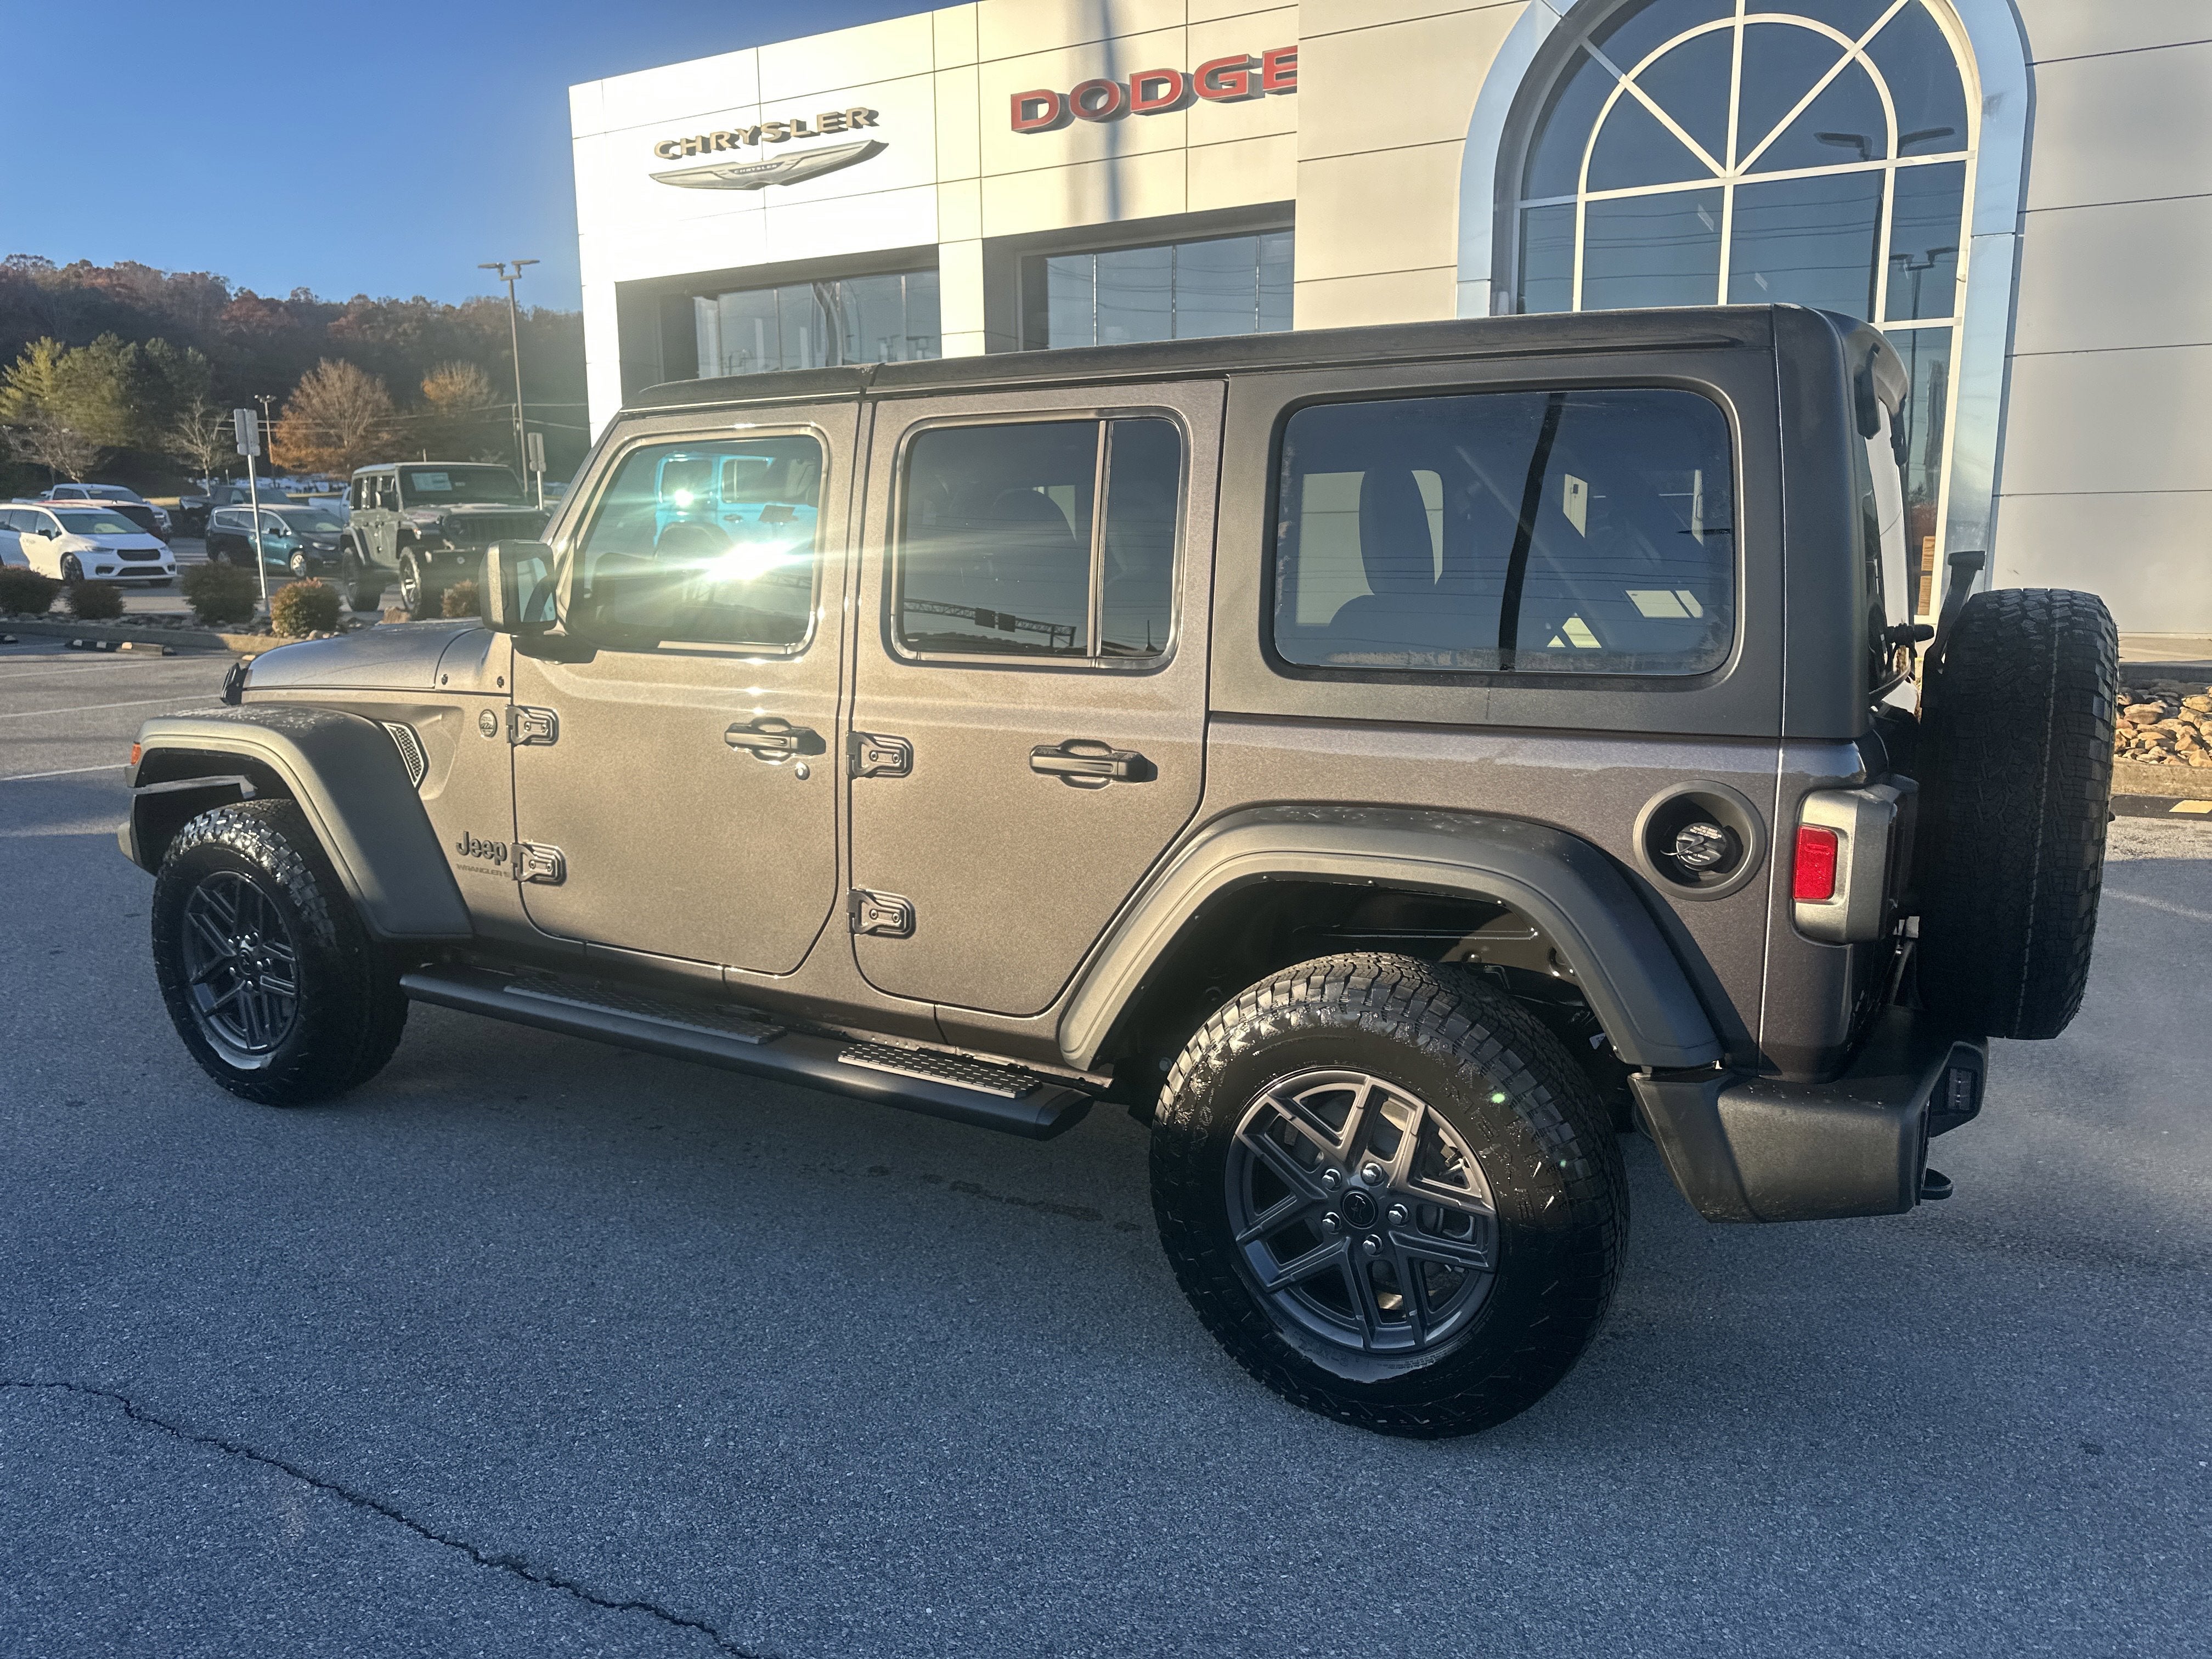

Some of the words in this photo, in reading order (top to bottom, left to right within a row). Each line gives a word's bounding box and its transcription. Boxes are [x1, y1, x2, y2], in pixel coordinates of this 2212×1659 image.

[1011, 45, 1298, 134] DODGE
[654, 107, 879, 160] CHRYSLER
[734, 165, 777, 173] CHRYSLER
[456, 831, 507, 866] Jeep
[456, 864, 503, 876] WRANGLER
